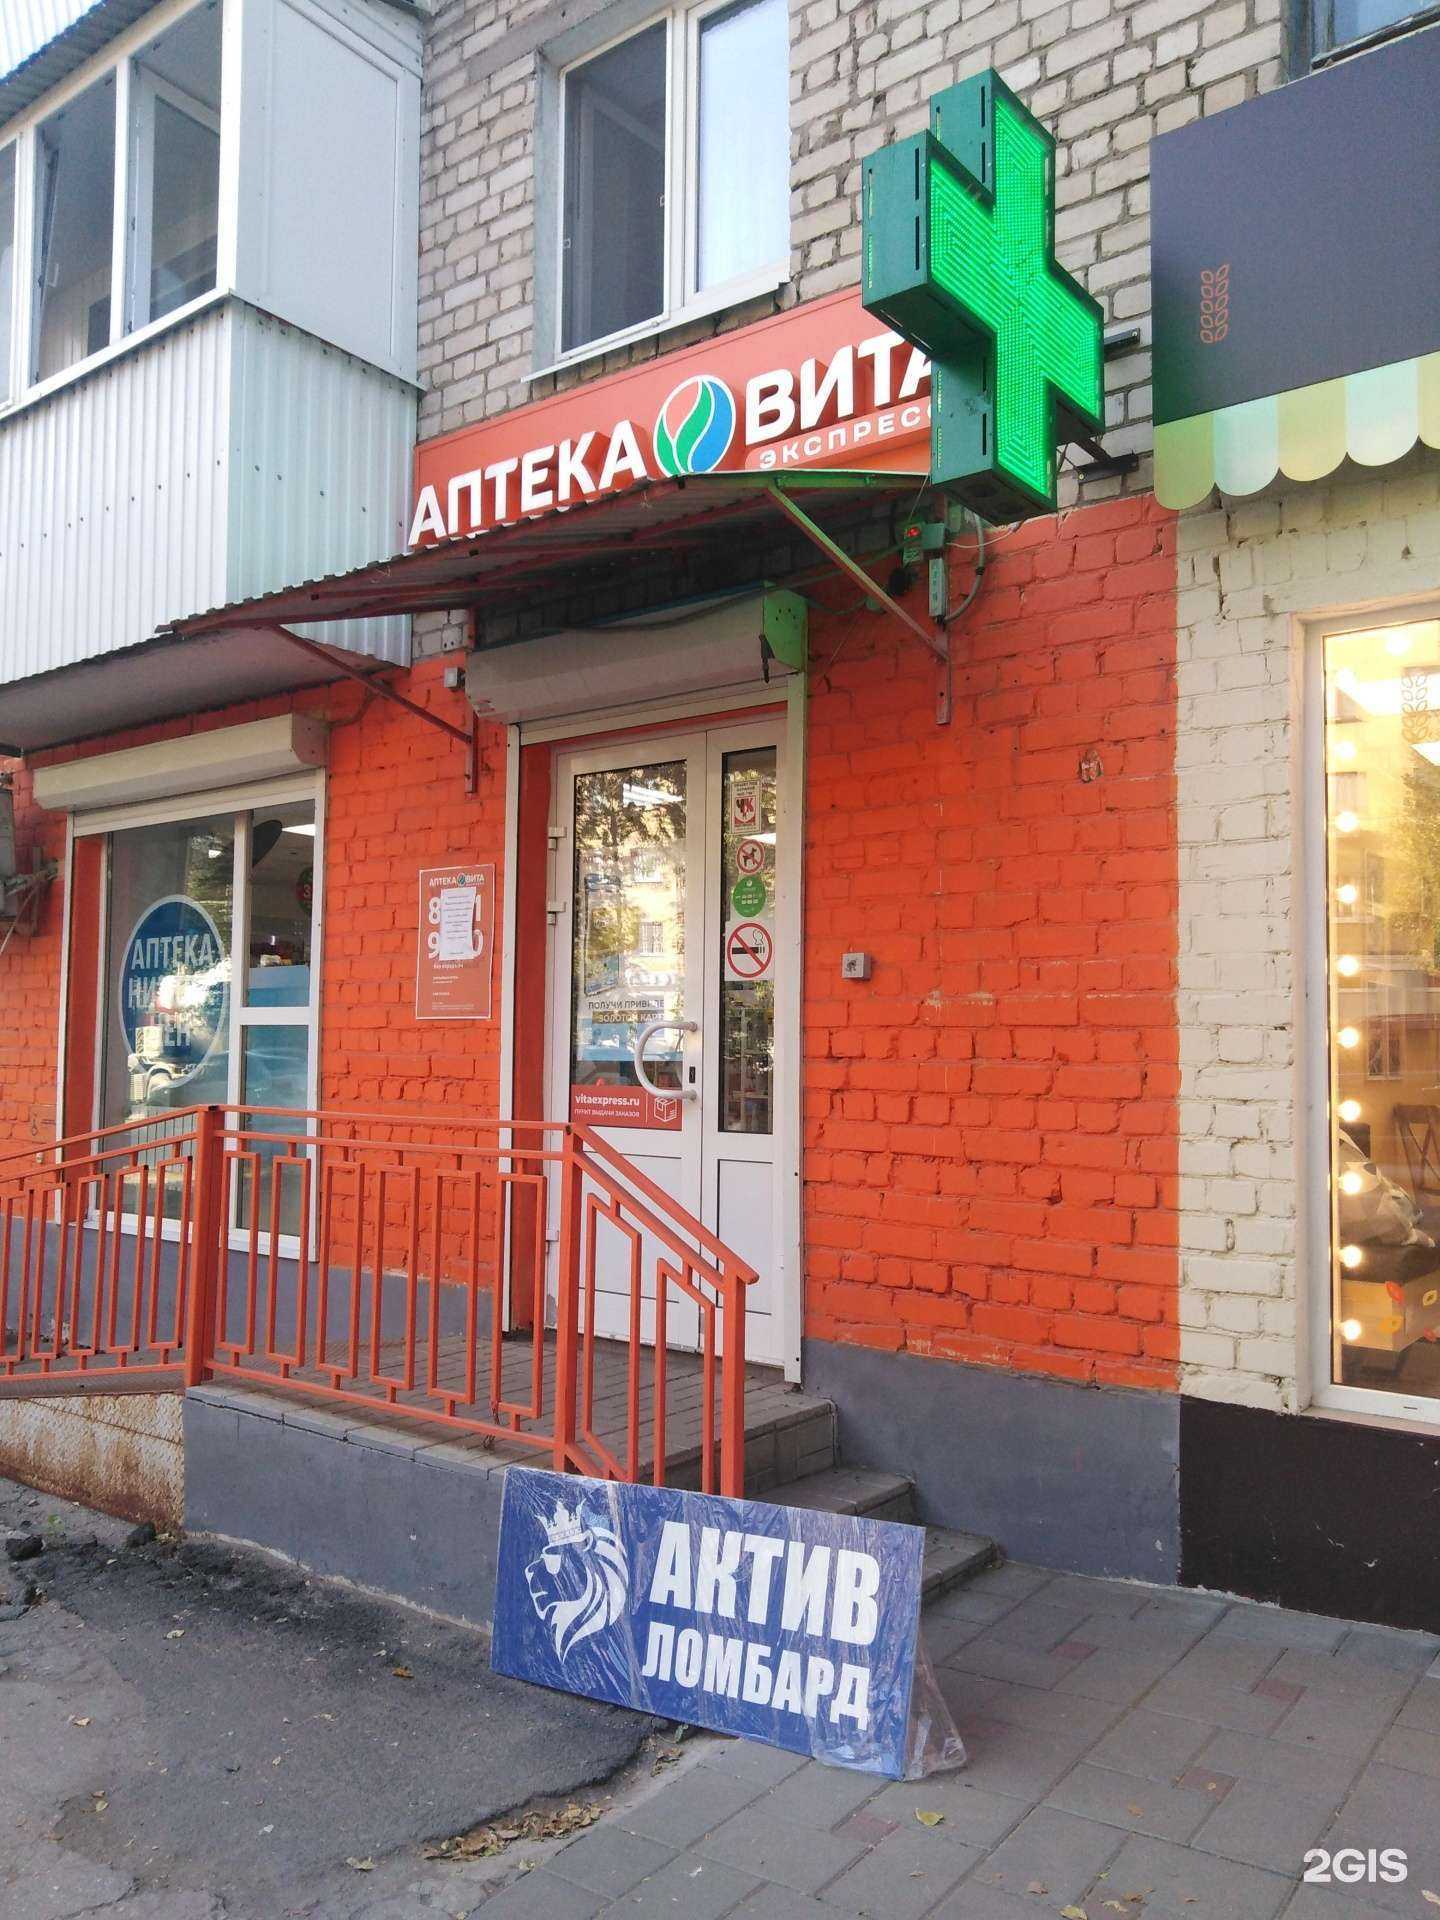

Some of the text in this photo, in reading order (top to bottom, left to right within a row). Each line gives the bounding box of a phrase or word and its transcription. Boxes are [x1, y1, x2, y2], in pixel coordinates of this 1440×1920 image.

[758, 402, 932, 470] ЭКСПРЕС
[408, 419, 647, 547] АПТЕКА
[429, 873, 485, 887] АПТЕКА ВИТА
[131, 933, 216, 971] АПТЕКА
[588, 1000, 623, 1010] ПОЛУЧИ
[575, 1093, 640, 1107] vitaexpress.ru
[615, 1110, 640, 1118] ЗАКАЗОВ
[648, 1520, 881, 1646] АКТИВ
[641, 1620, 871, 1732] ЛОМБАРД
